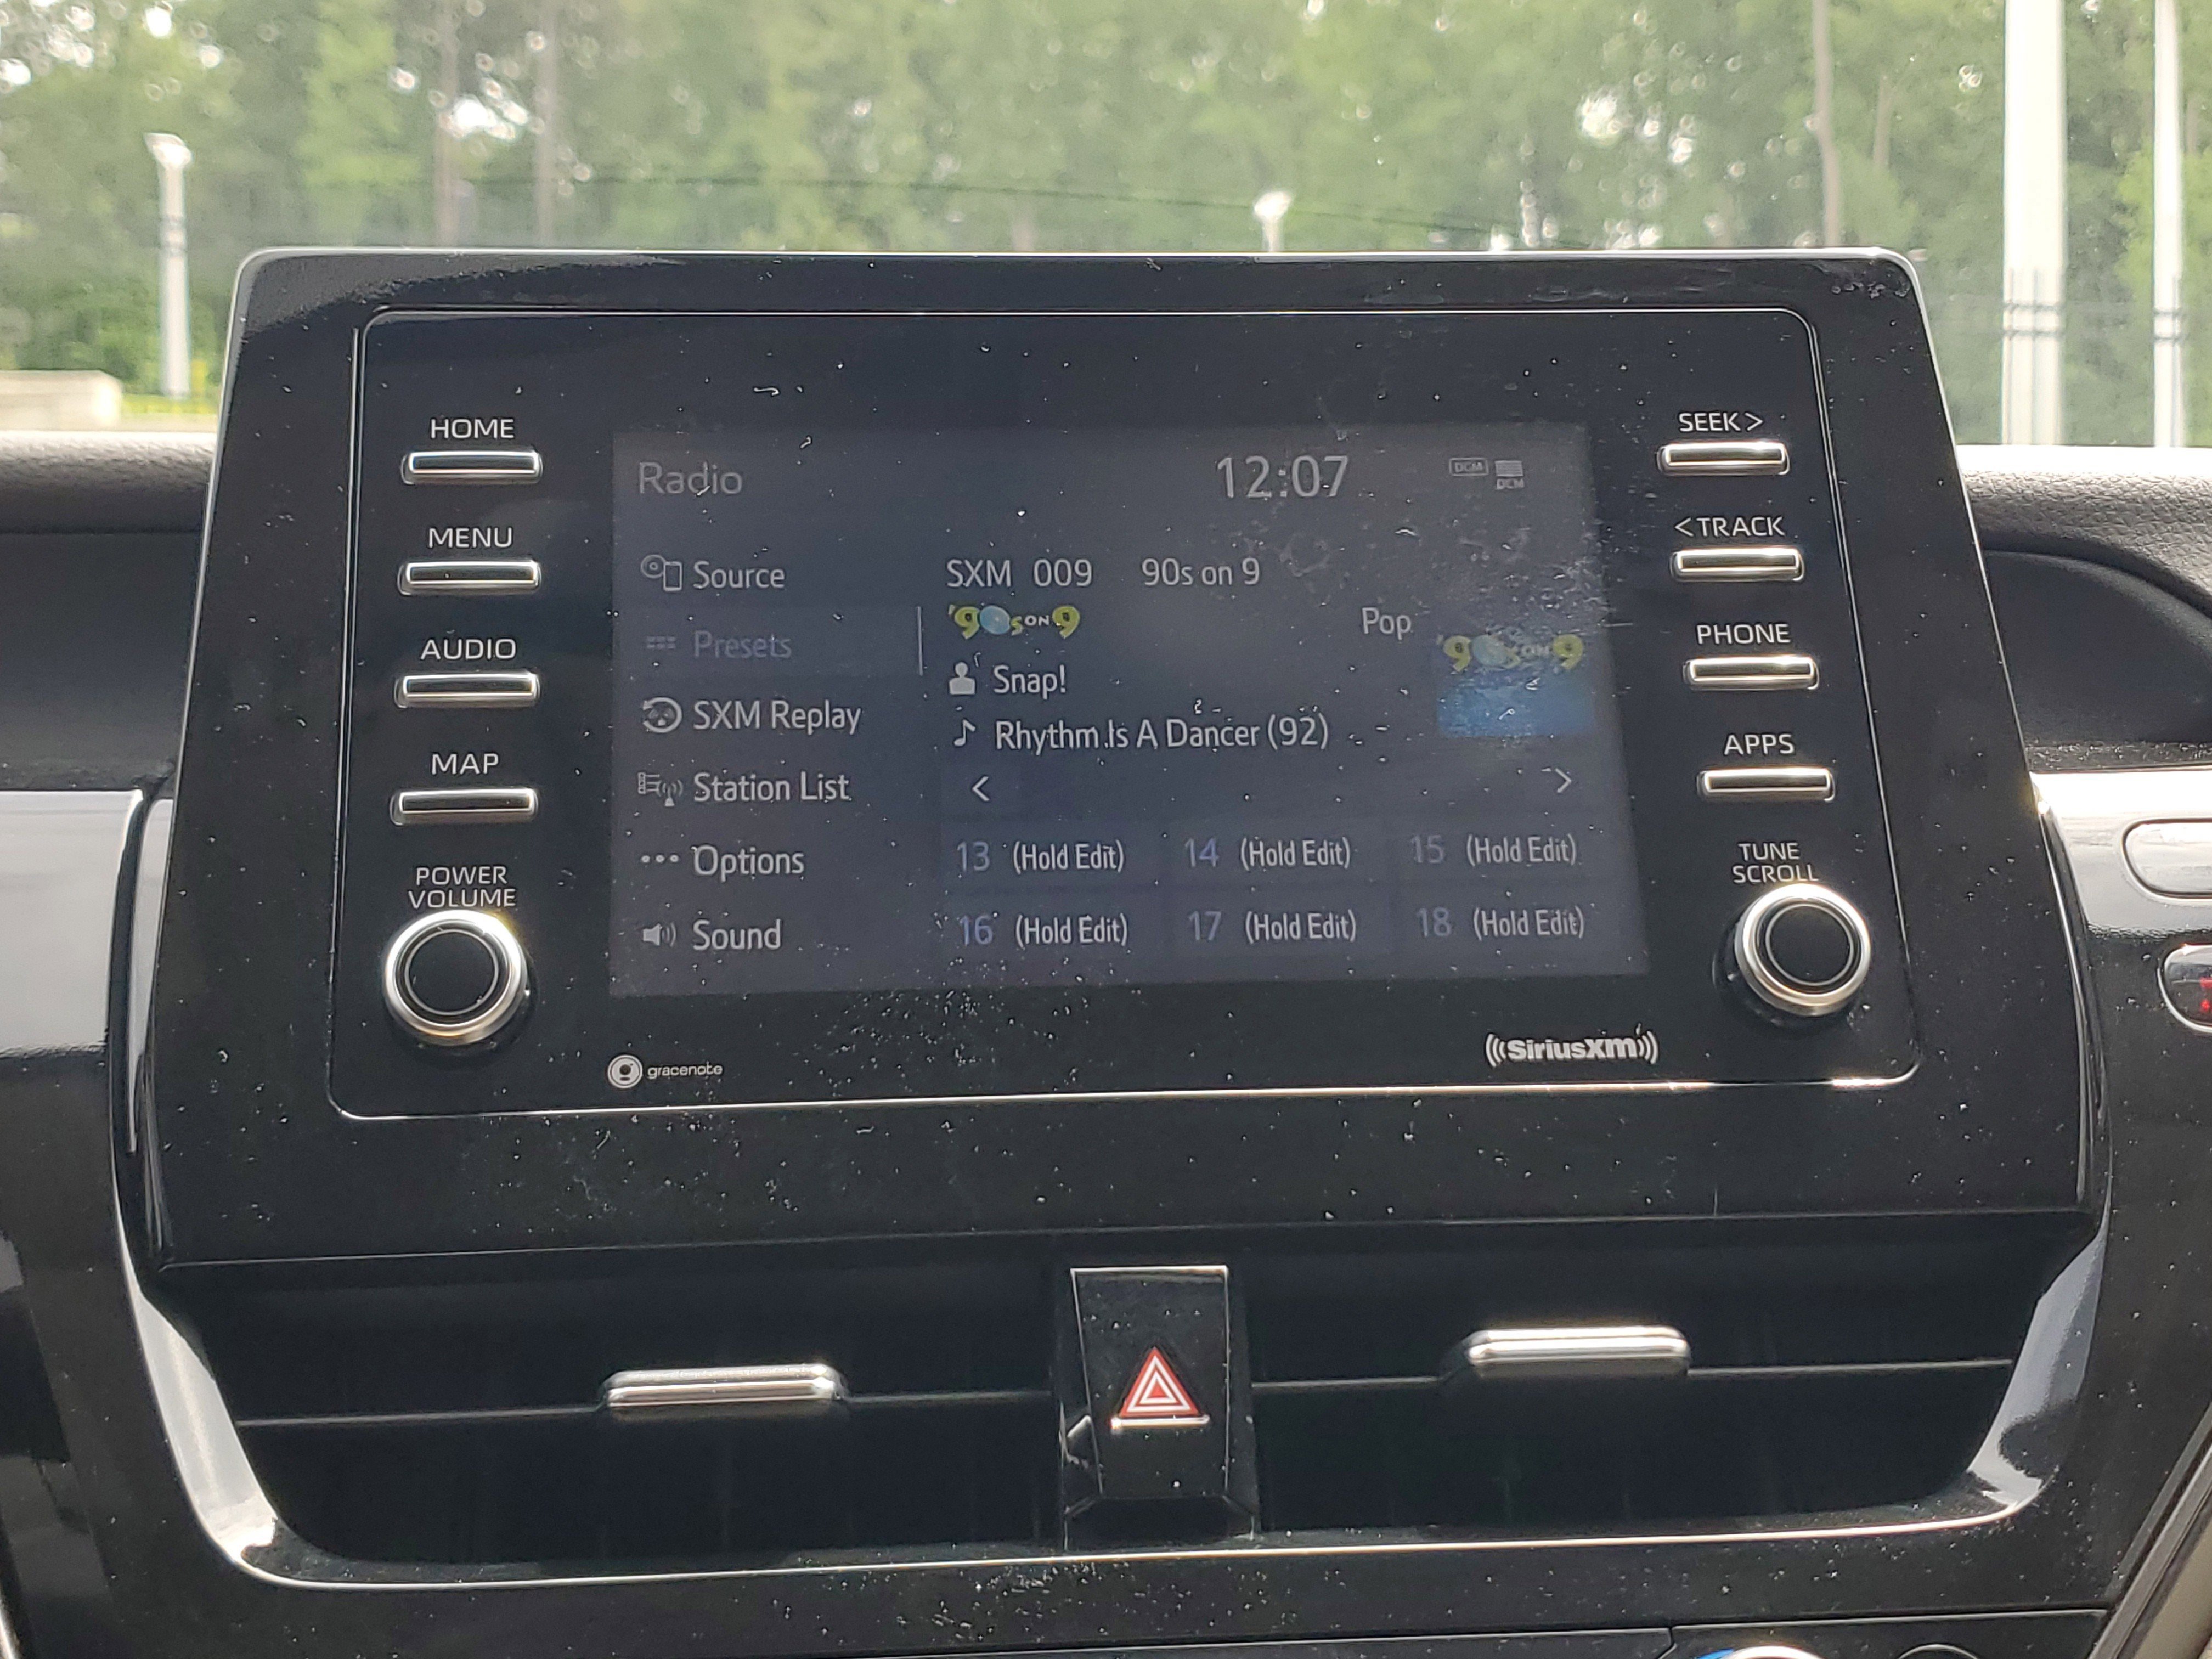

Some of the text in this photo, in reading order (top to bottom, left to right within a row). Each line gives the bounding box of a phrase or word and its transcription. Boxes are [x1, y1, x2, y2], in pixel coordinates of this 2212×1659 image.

[430, 419, 515, 439] HOME
[639, 461, 743, 495] Radio
[1217, 455, 1349, 498] 12:07
[428, 527, 512, 548] MENU
[693, 561, 786, 589] Source
[946, 559, 1093, 588] SXM 009
[1141, 557, 1260, 586] 90s on 9
[1052, 605, 1081, 639] 9
[1362, 607, 1412, 641] Pop
[1696, 623, 1791, 644] PHONE
[420, 639, 517, 659] AUDIO
[694, 630, 792, 658] Presets
[993, 664, 1066, 699] Snap!
[693, 700, 862, 735] SXM Replay
[996, 713, 1329, 755] Rhythm Is A Dancer (92)
[1724, 733, 1795, 756] APPS
[431, 753, 499, 775] MAP
[693, 771, 850, 802] Station List
[693, 845, 805, 882] Options
[957, 839, 1125, 875] 13 (Hold Edit)
[1184, 837, 1351, 871] 14 (Hold Edit)
[1411, 833, 1577, 867] 15 (Hold Edit)
[1738, 843, 1801, 861] TUNE
[416, 866, 508, 886] POWER
[1732, 864, 1820, 884] SCROLL
[408, 888, 516, 910] VOLUME
[693, 919, 782, 950] Sound
[959, 913, 1128, 948] 16 (Hold Edit)
[1188, 909, 1357, 944] 17 (Hold Edit)
[1417, 906, 1584, 941] 18 (Hold Edit)
[647, 1061, 723, 1080] gracenote
